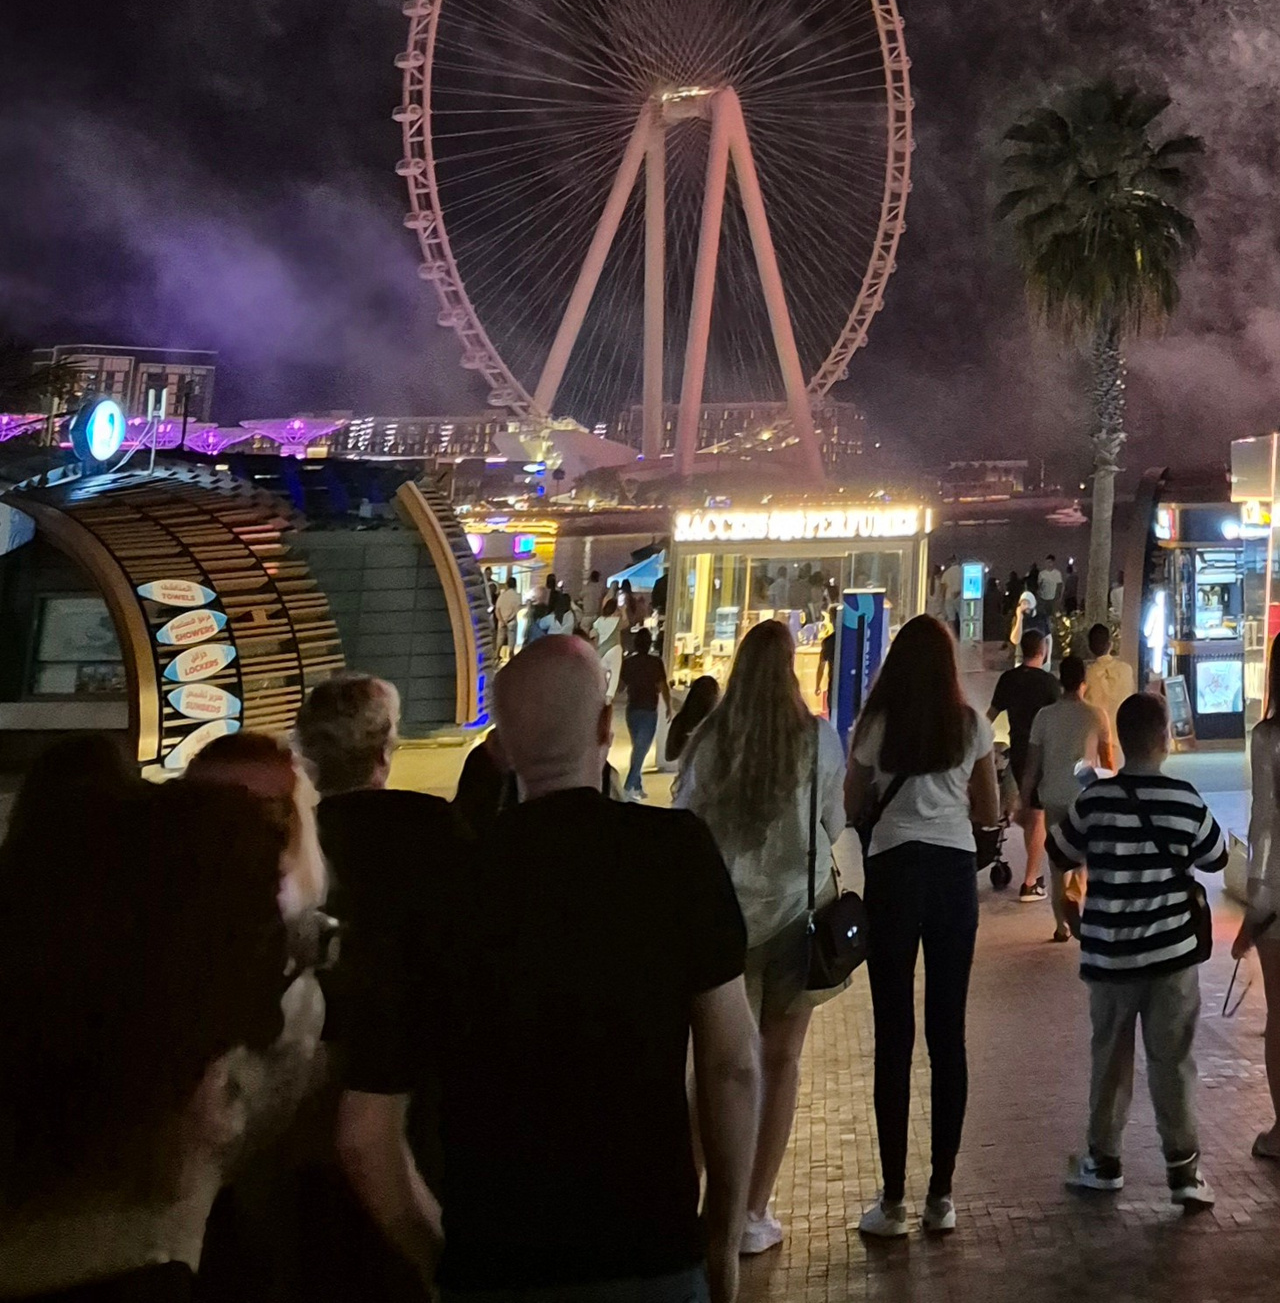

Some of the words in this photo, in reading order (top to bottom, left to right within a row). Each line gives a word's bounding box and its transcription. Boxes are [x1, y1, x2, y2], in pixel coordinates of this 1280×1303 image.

[161, 592, 196, 602] TOWELS
[174, 624, 216, 643] SHOWERS
[184, 657, 219, 676] LOCKERS
[185, 701, 222, 714] SUNBEDS
